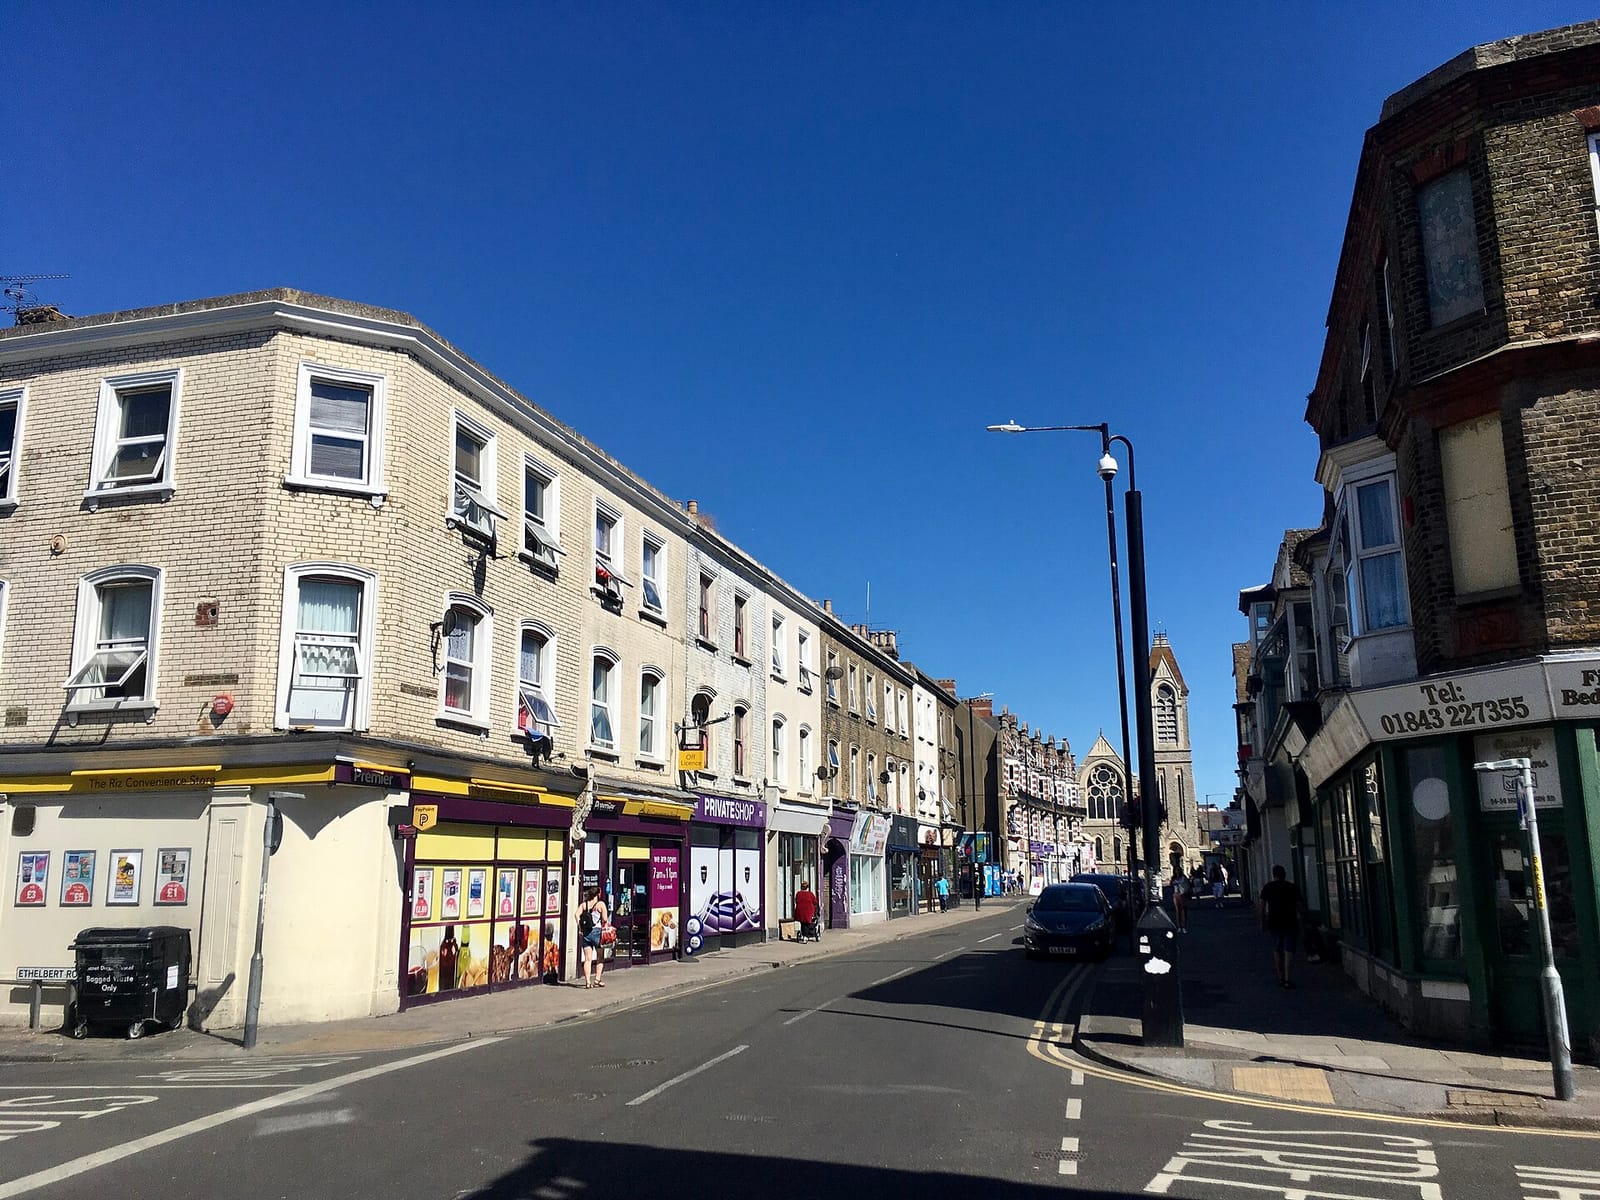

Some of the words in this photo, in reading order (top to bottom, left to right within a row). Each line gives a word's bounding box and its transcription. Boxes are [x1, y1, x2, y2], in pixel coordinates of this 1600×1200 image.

[1421, 682, 1466, 707] Tel:
[1381, 707, 1444, 735] 01843
[1446, 696, 1530, 727] 227355
[89, 778, 105, 789] The
[109, 777, 123, 788] Riz
[125, 776, 187, 788] Convenience
[189, 774, 216, 786] Store
[353, 768, 394, 786] Premier
[667, 856, 677, 866] open
[26, 890, 36, 899] £3
[166, 887, 178, 898] £1
[18, 969, 64, 979] ETHELBERT
[86, 975, 111, 984] Bagged
[102, 984, 117, 992] Only
